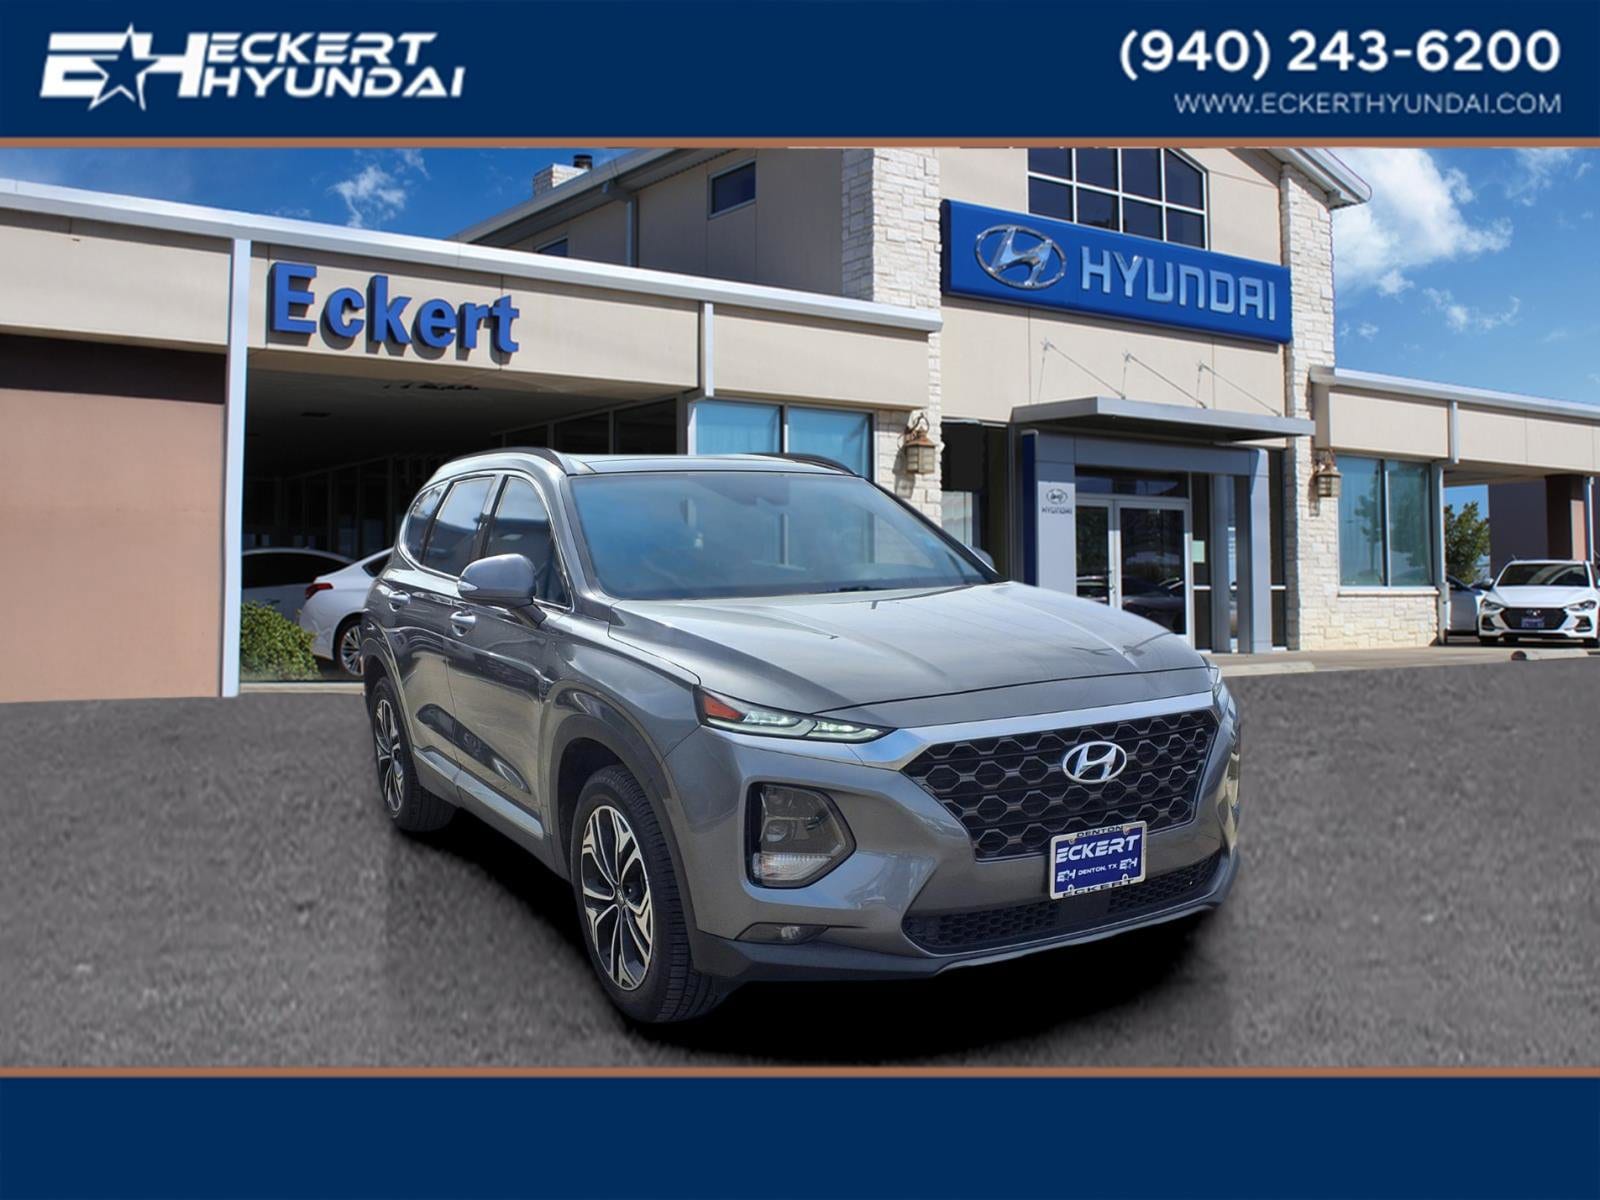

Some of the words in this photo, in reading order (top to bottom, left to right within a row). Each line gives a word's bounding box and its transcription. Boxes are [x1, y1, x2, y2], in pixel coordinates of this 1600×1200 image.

[1080, 246, 1277, 321] HYUNDAI
[267, 261, 520, 354] Eckert
[1076, 825, 1124, 838] DENTON
[1056, 834, 1140, 864] ECKERT
[1078, 867, 1106, 876] DENTON,
